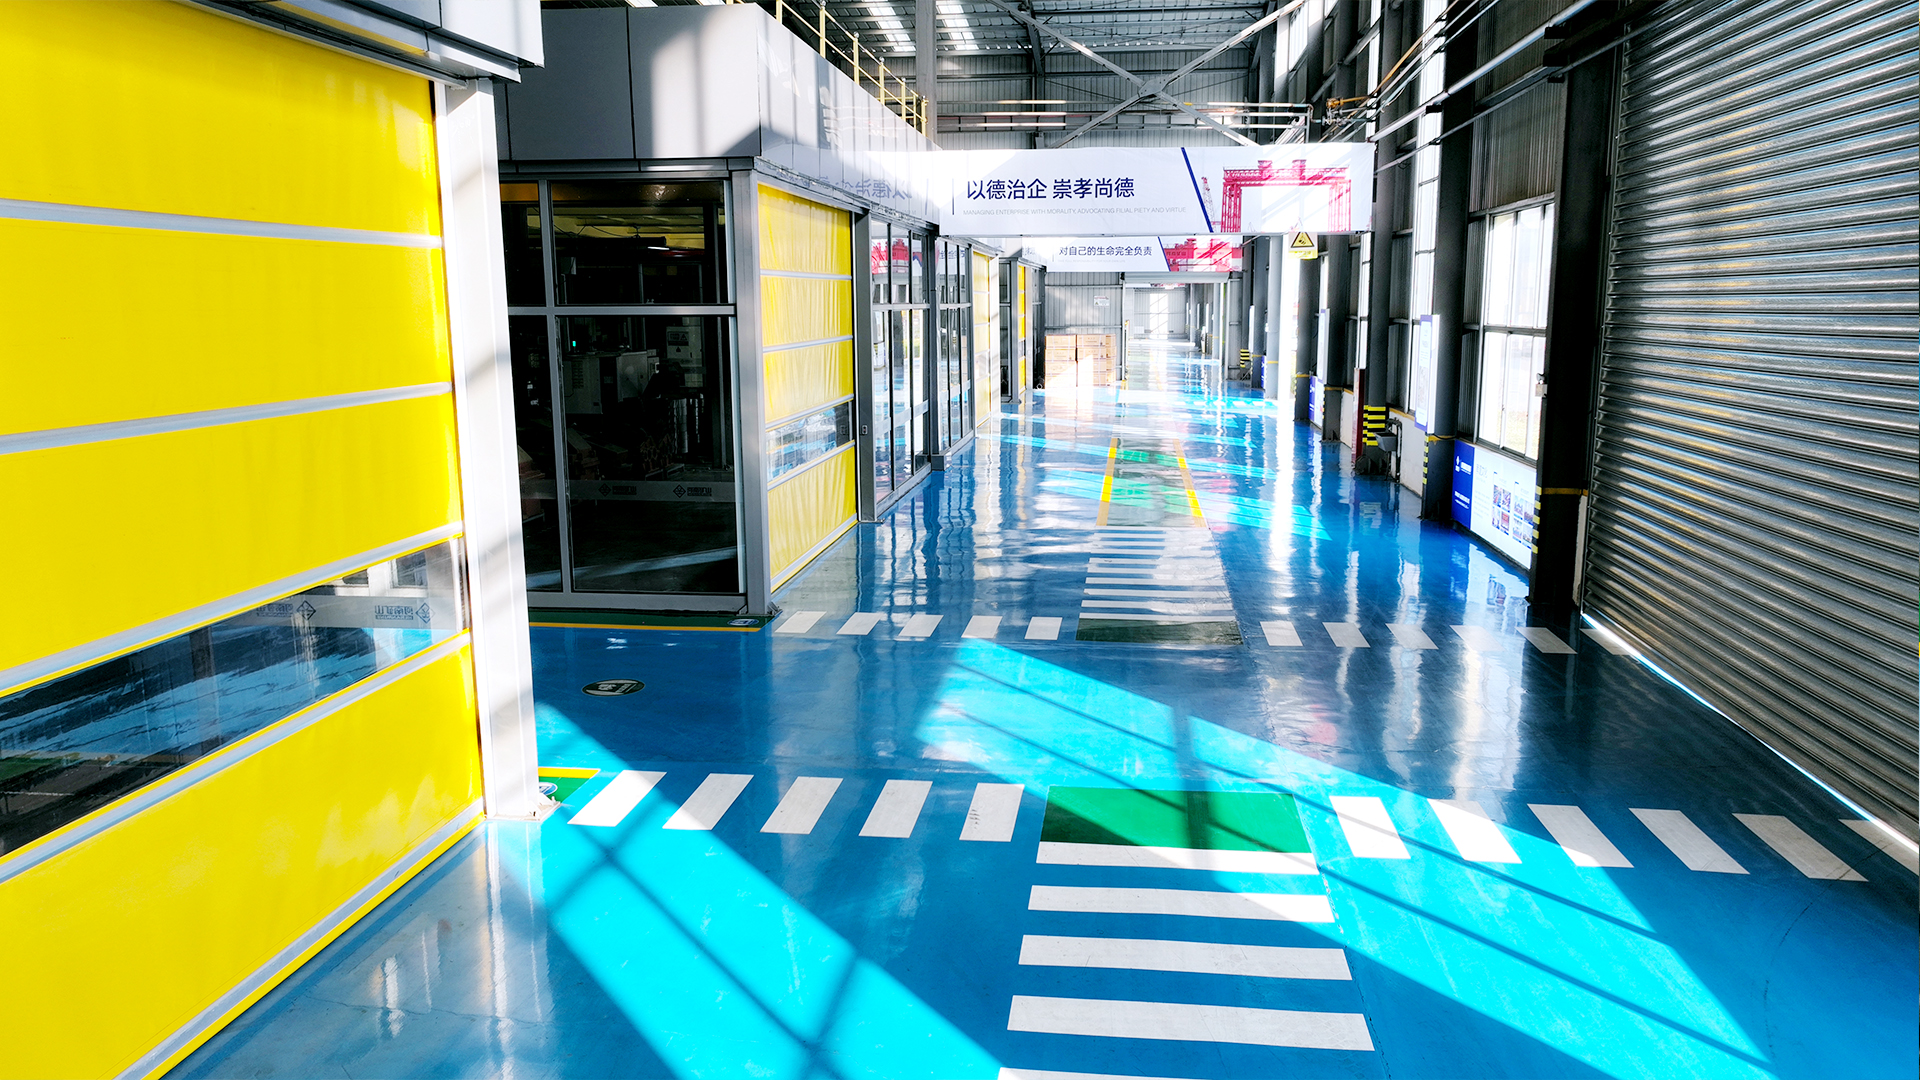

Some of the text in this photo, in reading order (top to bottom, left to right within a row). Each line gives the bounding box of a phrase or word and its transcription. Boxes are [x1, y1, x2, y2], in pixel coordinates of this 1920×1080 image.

[967, 178, 1135, 200] 以德治企 崇孝尚德
[1059, 246, 1153, 257] 对自己的生命完全负责
